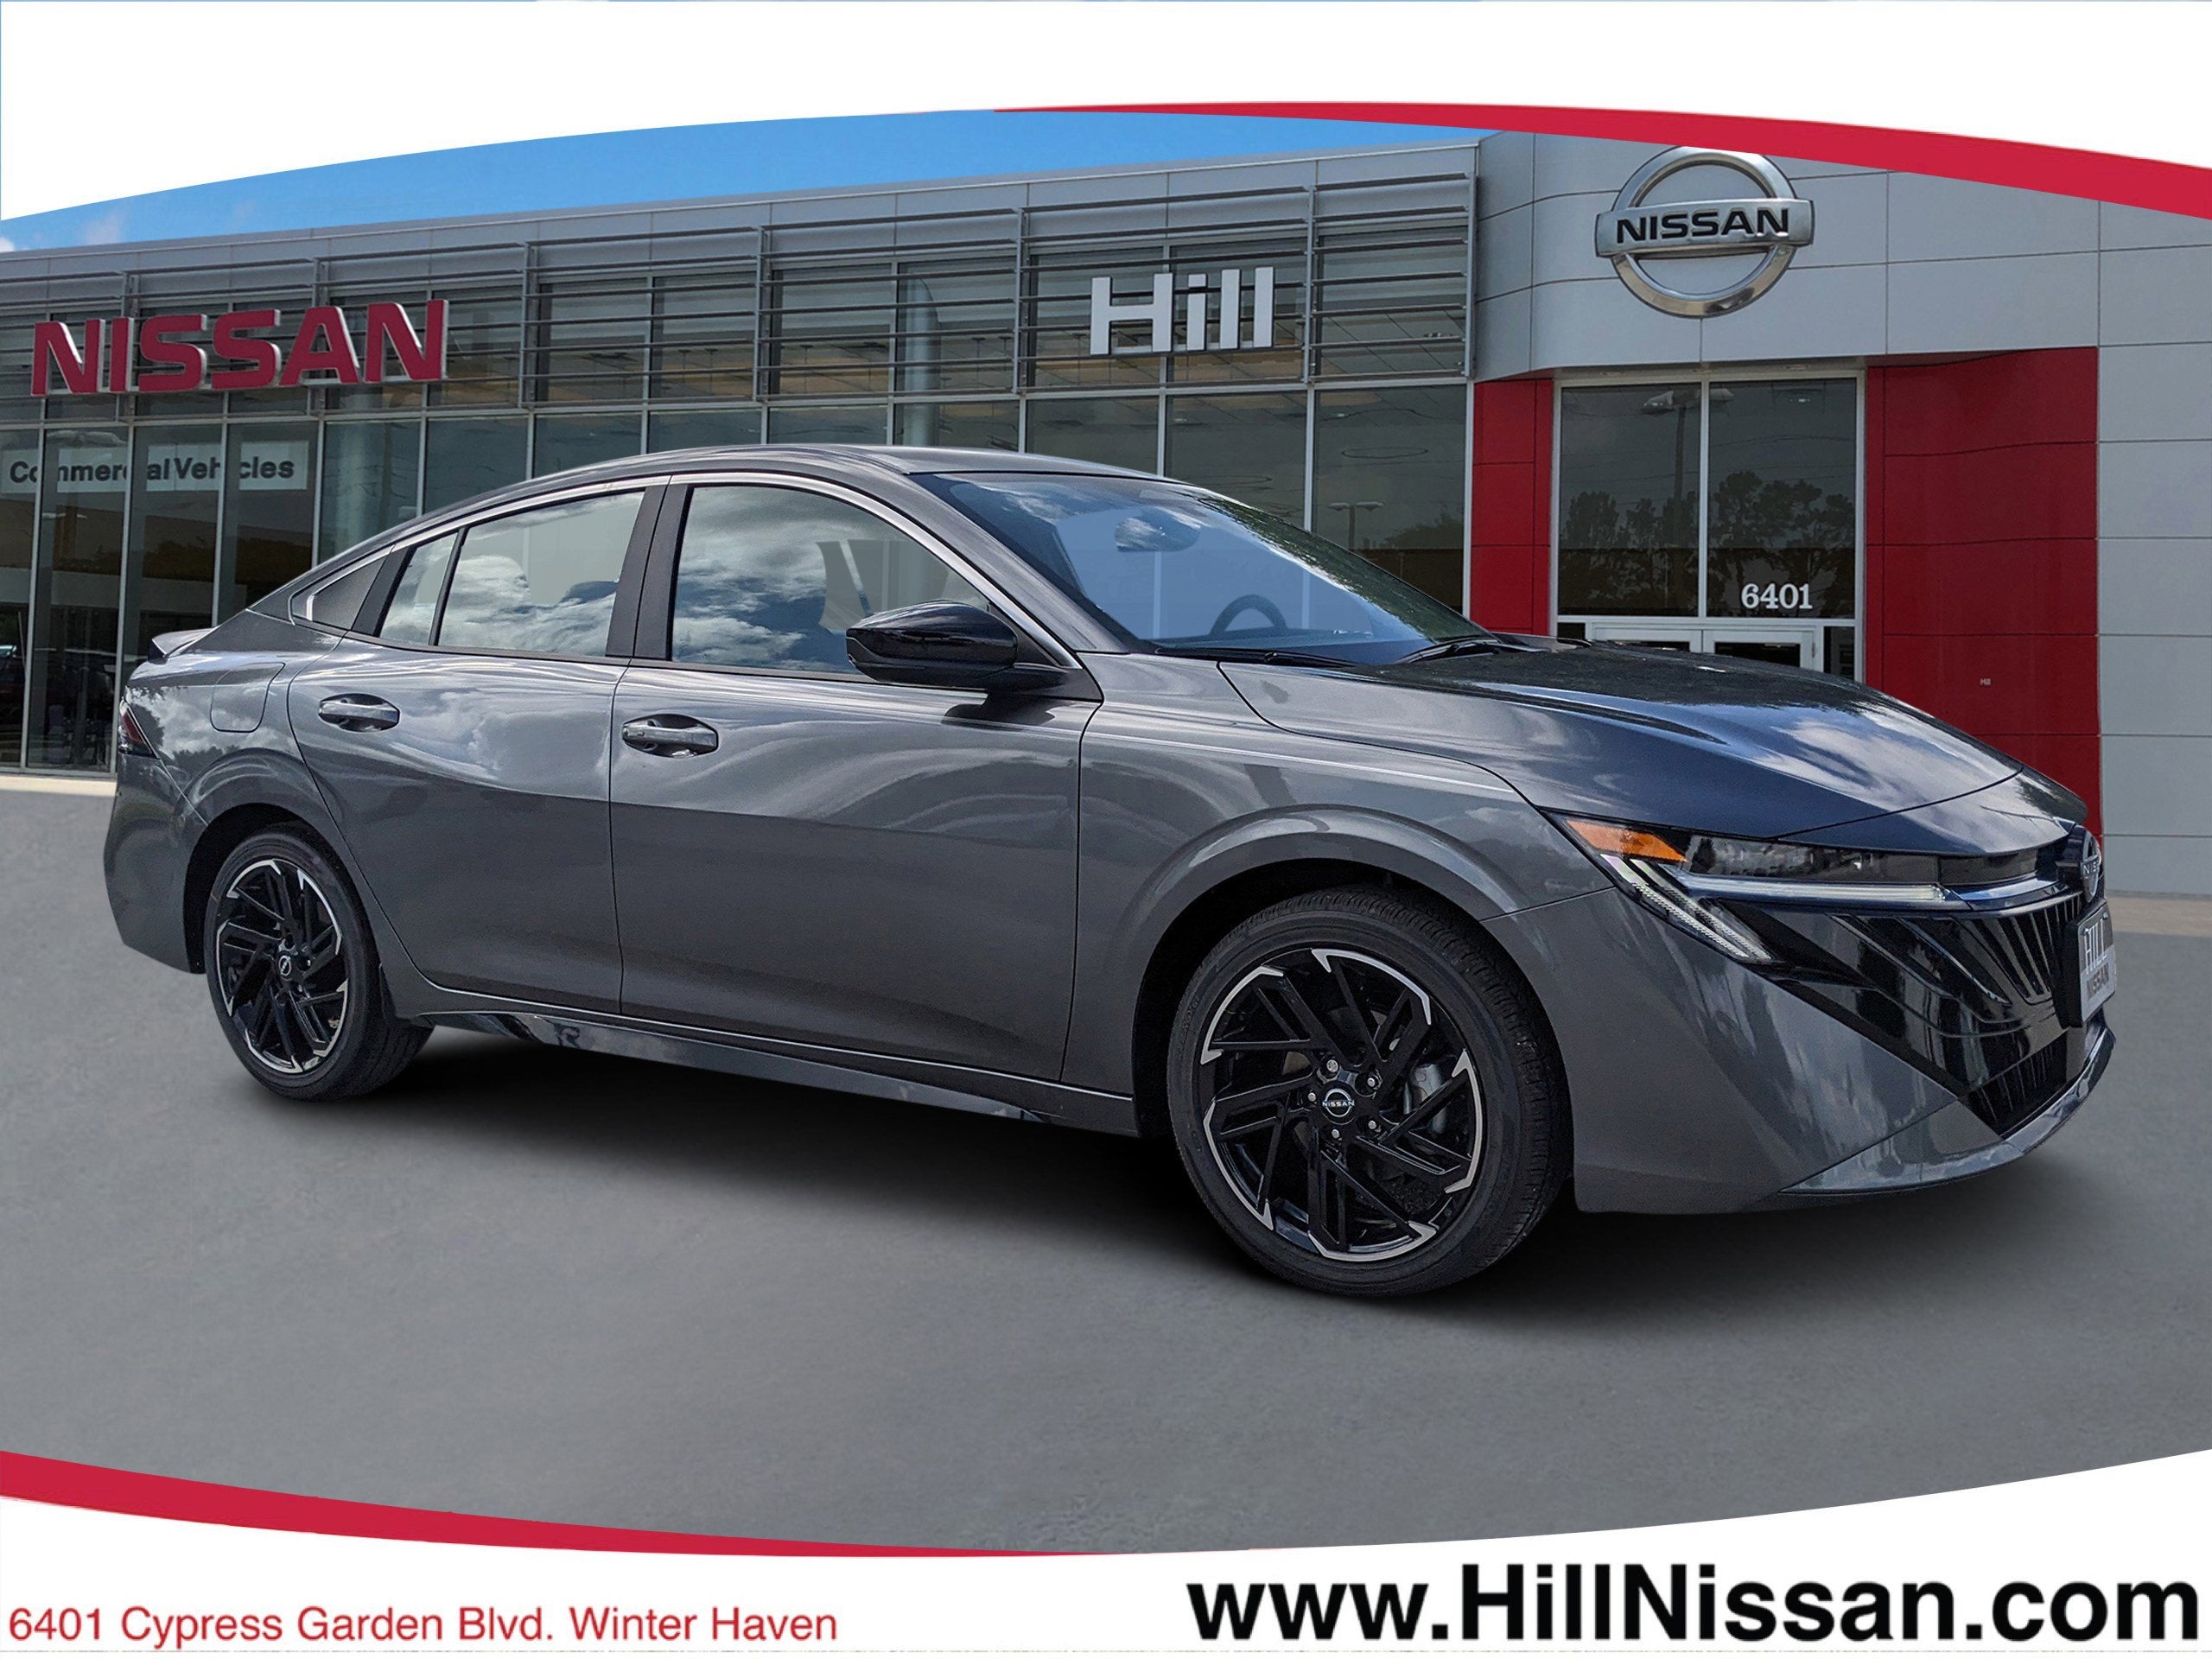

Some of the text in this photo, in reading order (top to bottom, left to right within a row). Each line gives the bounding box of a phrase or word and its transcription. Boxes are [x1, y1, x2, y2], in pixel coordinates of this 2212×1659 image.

[1616, 208, 1789, 244] NISSAN
[1090, 267, 1276, 356] Hill
[31, 299, 448, 397] NISSAN
[174, 455, 295, 479] Vehcles
[1740, 582, 1813, 609] 6401
